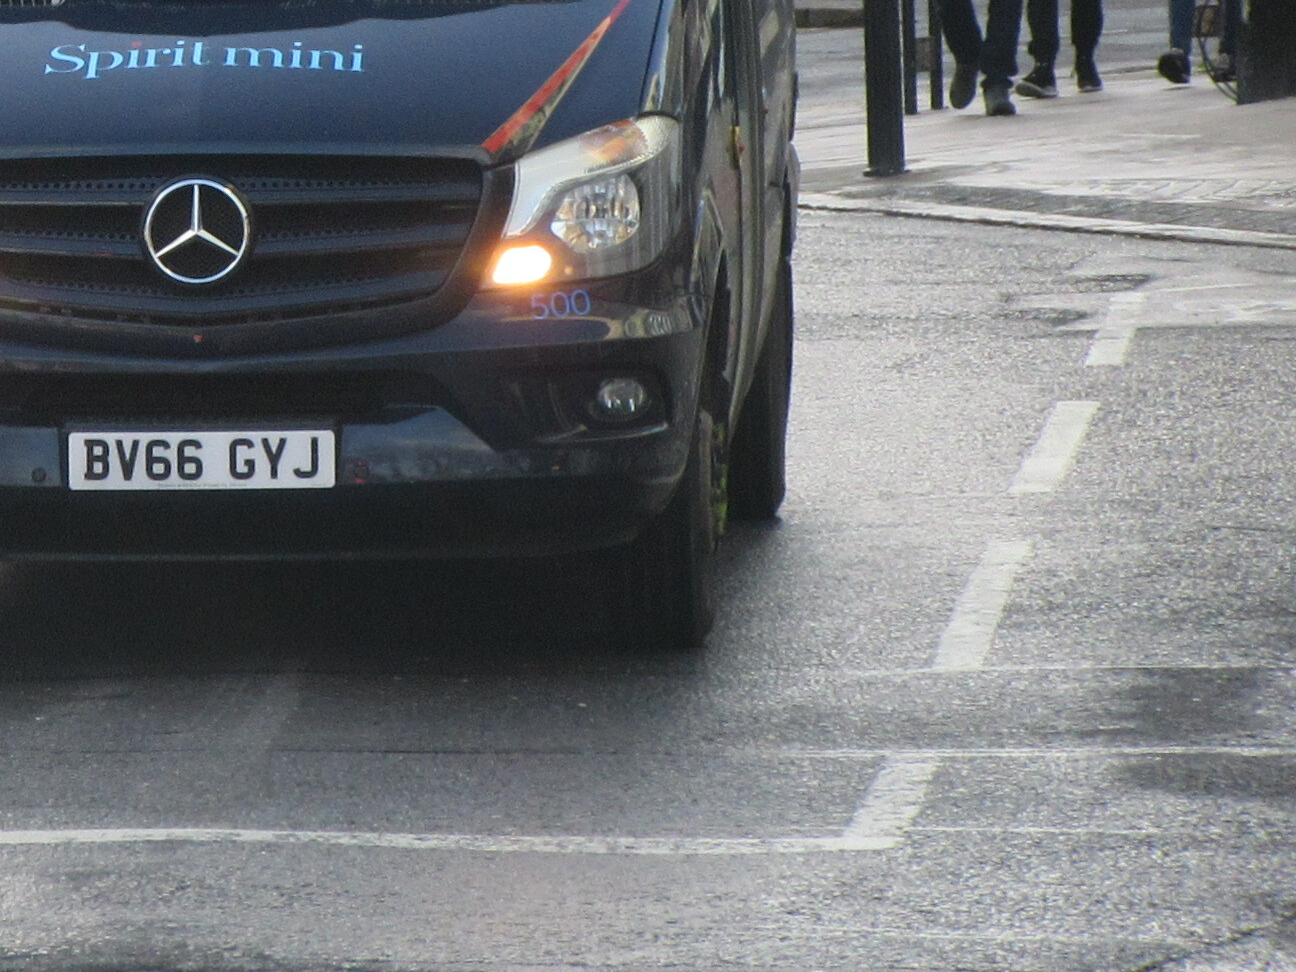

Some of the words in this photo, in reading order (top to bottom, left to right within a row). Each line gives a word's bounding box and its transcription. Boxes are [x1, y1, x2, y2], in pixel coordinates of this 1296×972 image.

[44, 39, 210, 80] Spirit
[222, 41, 365, 73] mini
[531, 288, 592, 320] 500
[83, 438, 204, 481] BV66
[229, 436, 320, 481] GYJ
